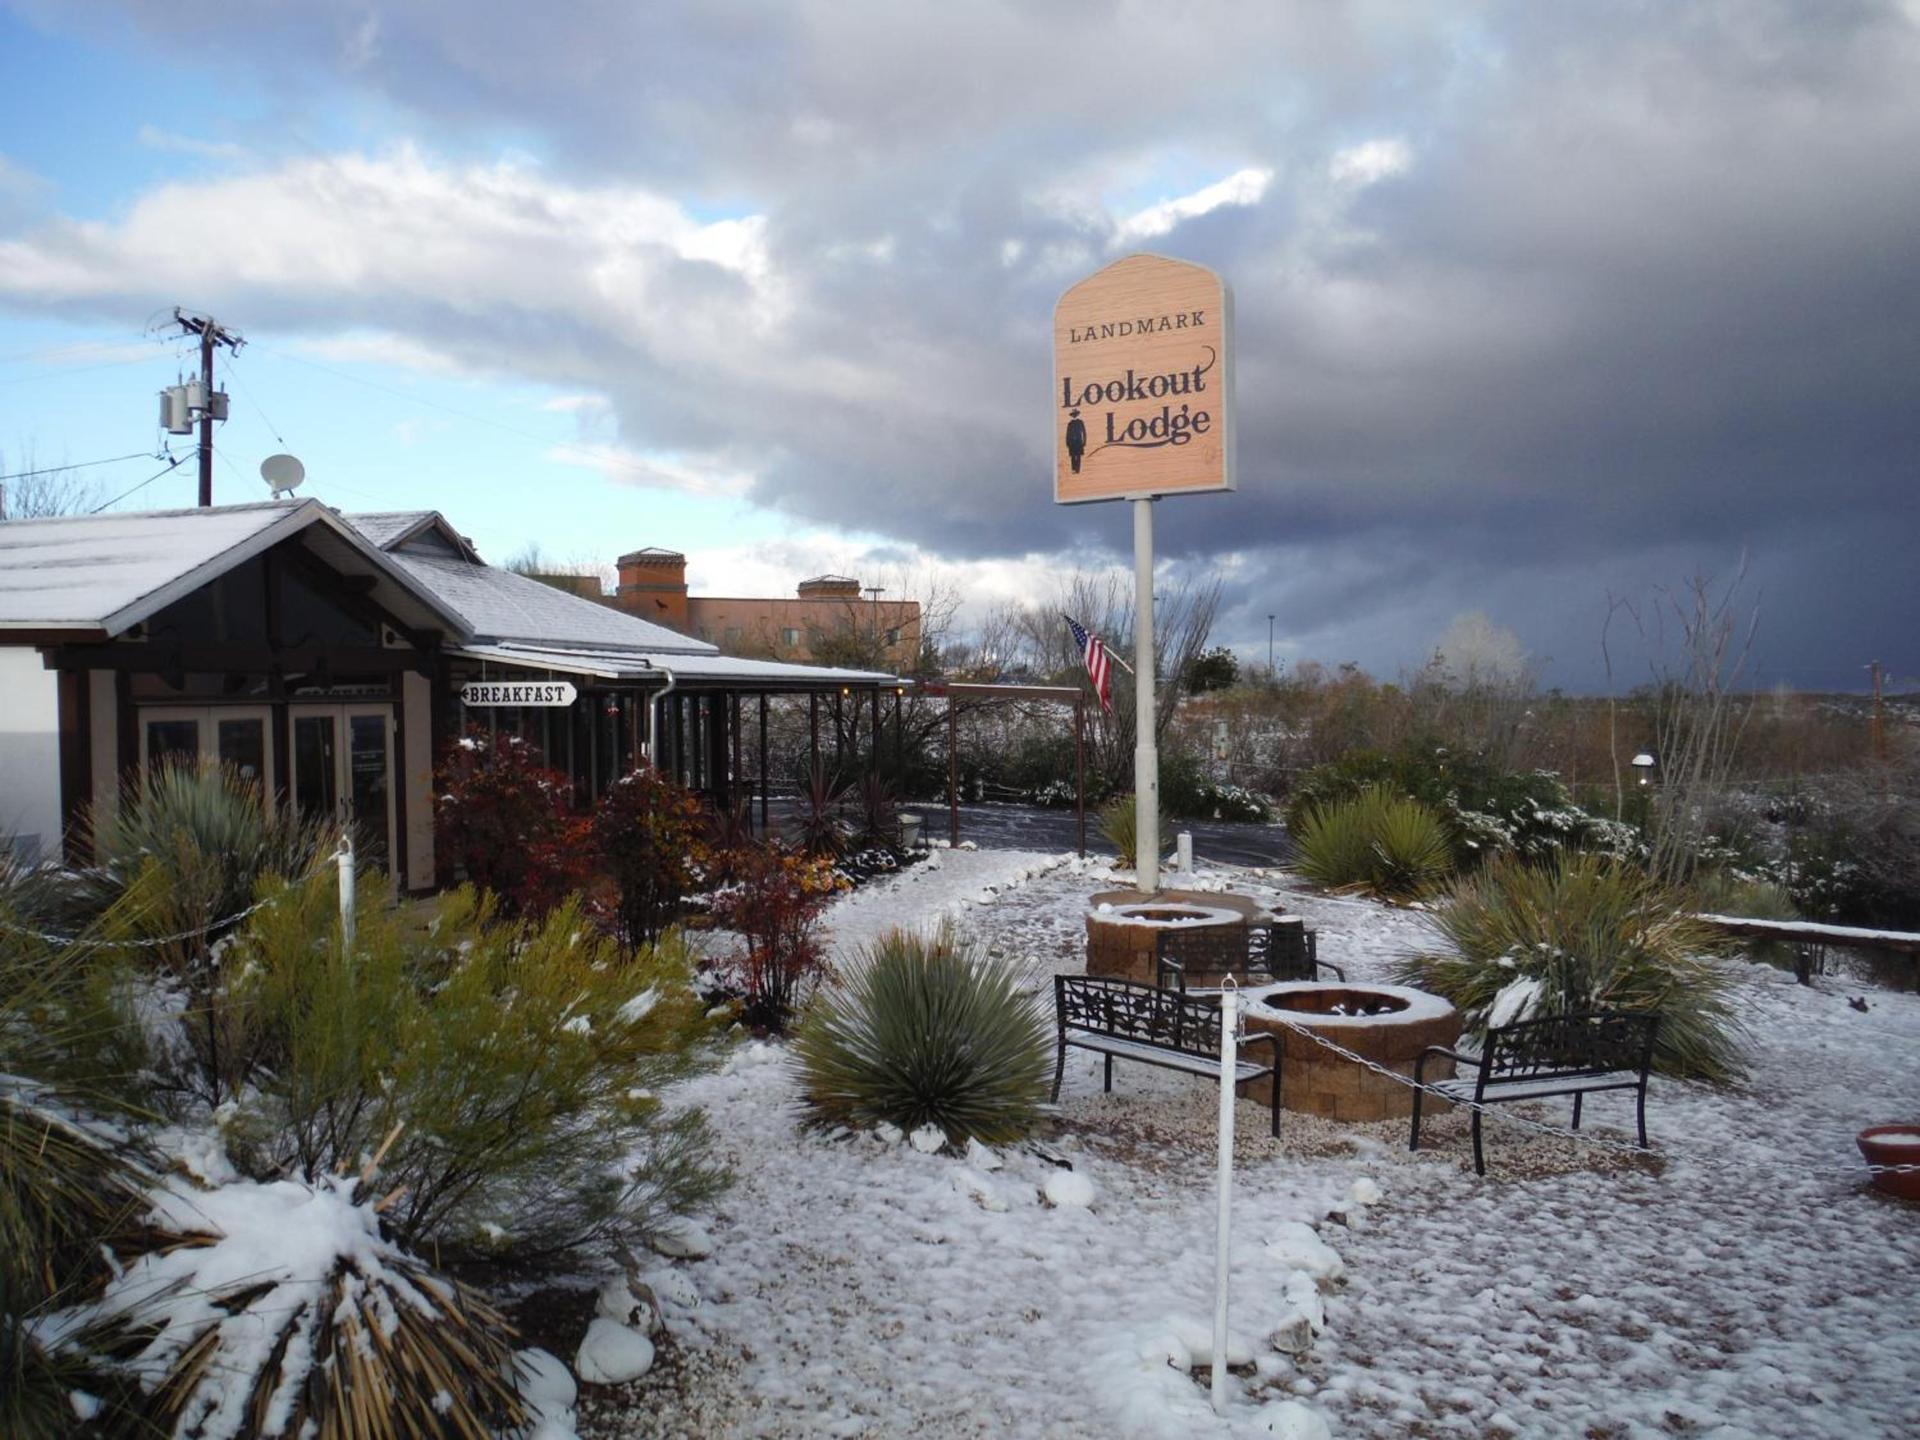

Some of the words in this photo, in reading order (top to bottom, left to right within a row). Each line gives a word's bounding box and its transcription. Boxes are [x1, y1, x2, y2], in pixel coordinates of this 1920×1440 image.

[1069, 311, 1206, 343] LANDMARK
[1061, 345, 1216, 409] Lookout
[1087, 404, 1211, 458] Lodge
[470, 686, 565, 703] BREAKFAST
